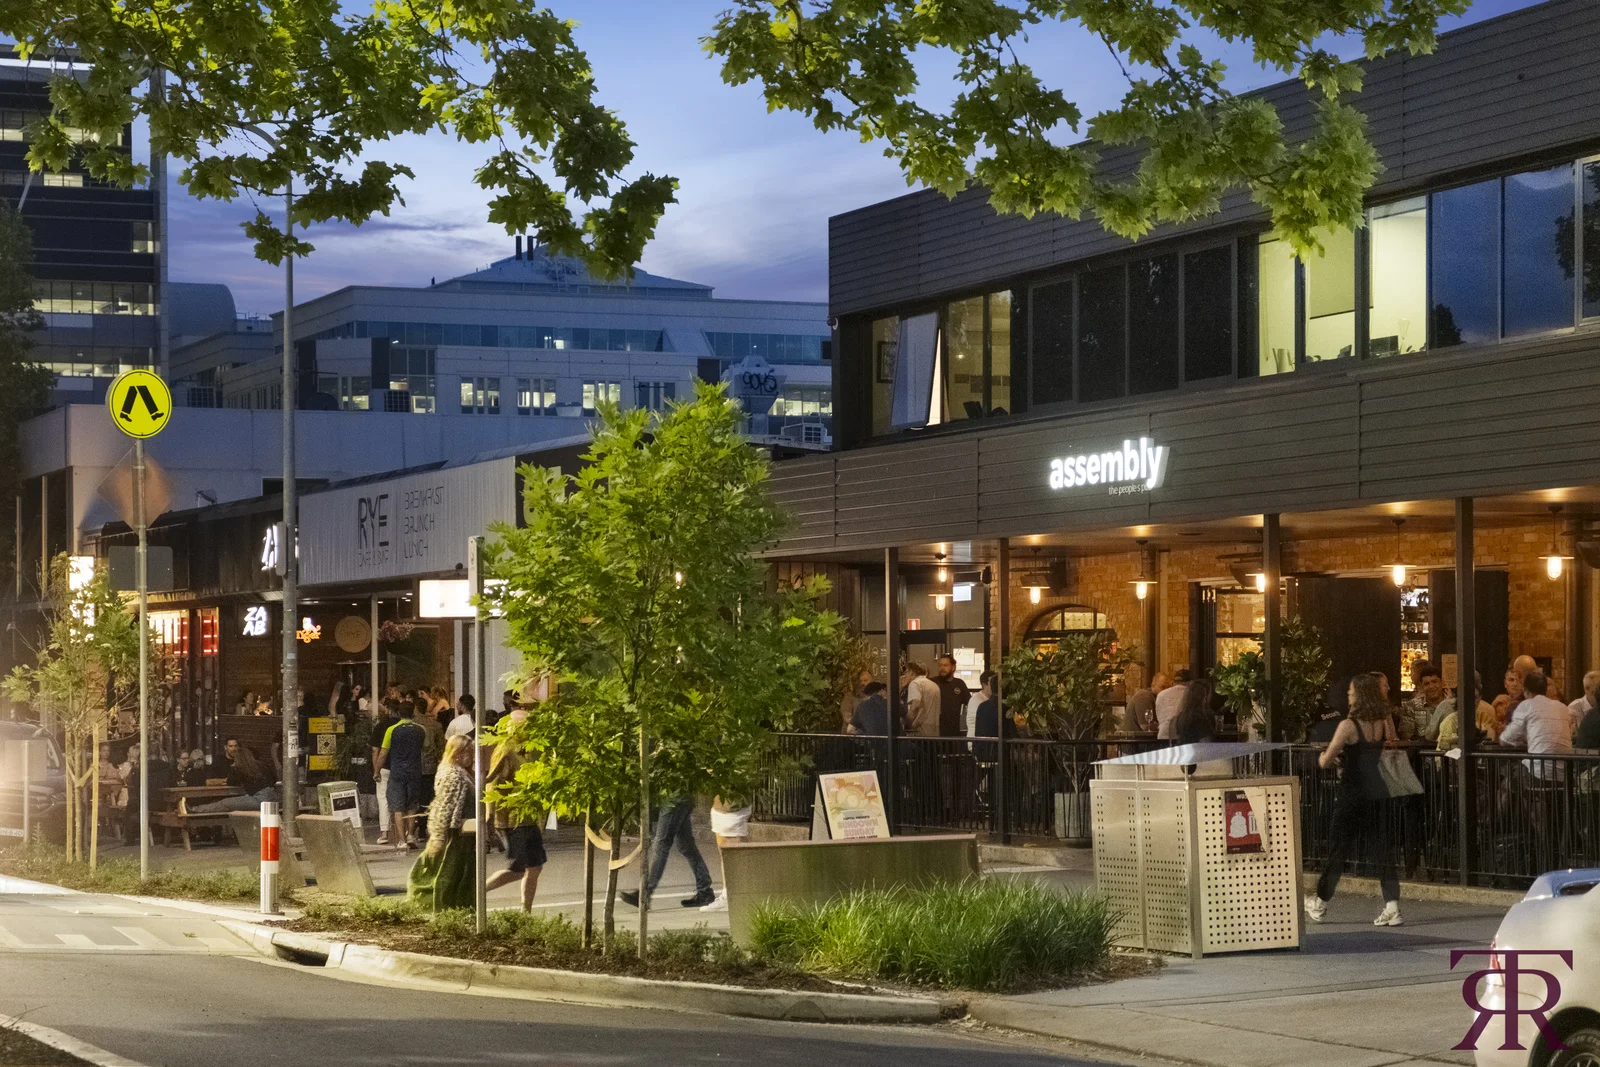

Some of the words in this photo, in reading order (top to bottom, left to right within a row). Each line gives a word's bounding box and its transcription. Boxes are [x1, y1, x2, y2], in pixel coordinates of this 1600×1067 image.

[1049, 436, 1166, 489] assembly
[403, 485, 444, 510] BREAKFAST
[1108, 486, 1118, 496] the
[358, 493, 389, 549] RYE
[403, 513, 434, 535] BRUNCH
[403, 539, 428, 559] LUNCH
[844, 827, 875, 836] SUNDAY
